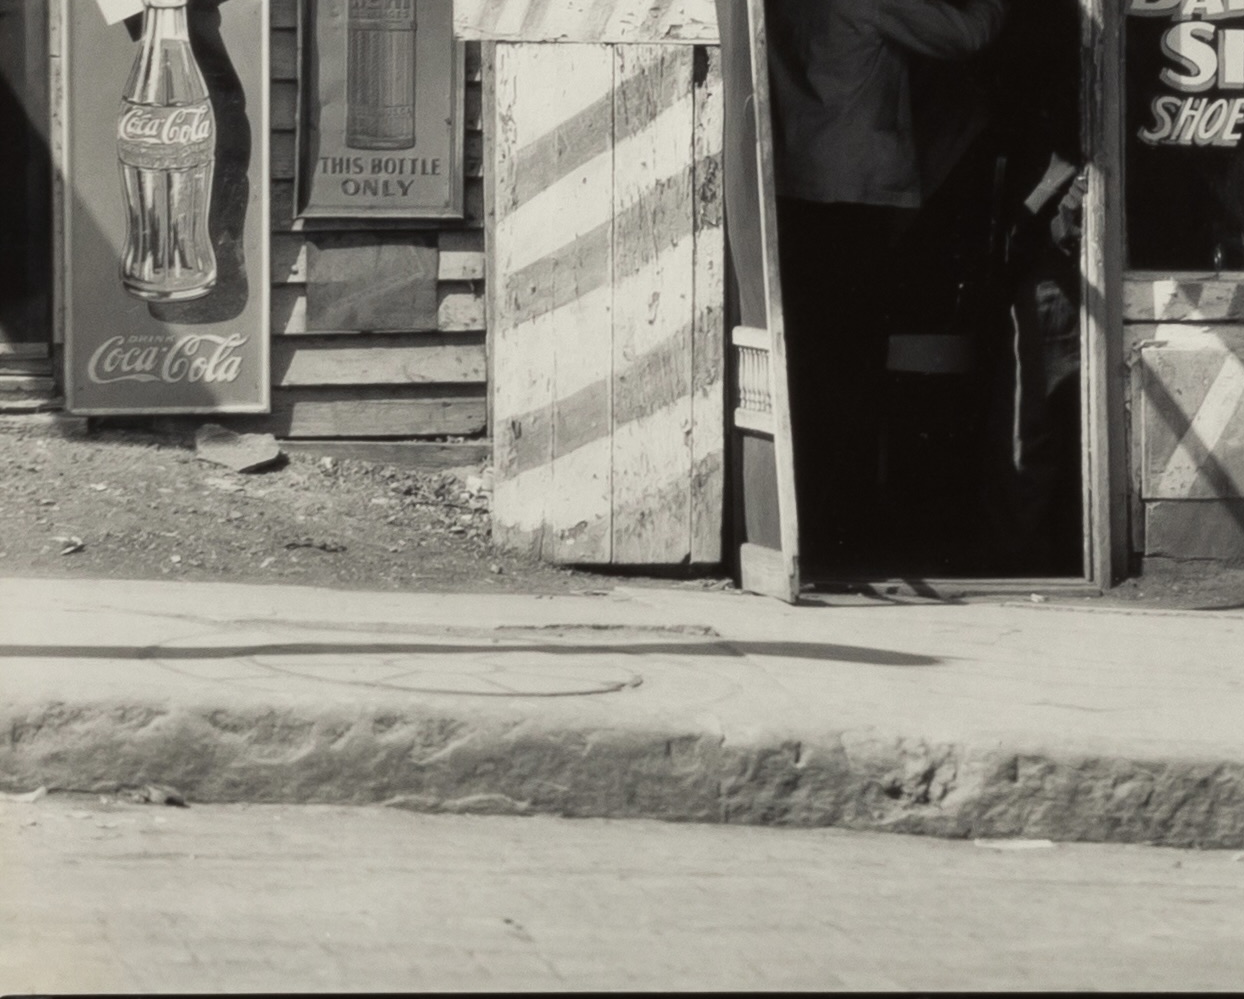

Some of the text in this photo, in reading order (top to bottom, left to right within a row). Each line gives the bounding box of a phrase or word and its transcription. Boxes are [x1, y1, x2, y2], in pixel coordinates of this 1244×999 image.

[119, 104, 211, 145] Coca-Cola
[320, 156, 441, 176] THIS BOTTLE
[340, 178, 415, 197] ONLY
[128, 335, 177, 343] DRINK
[88, 333, 250, 385] Coca-Cola
